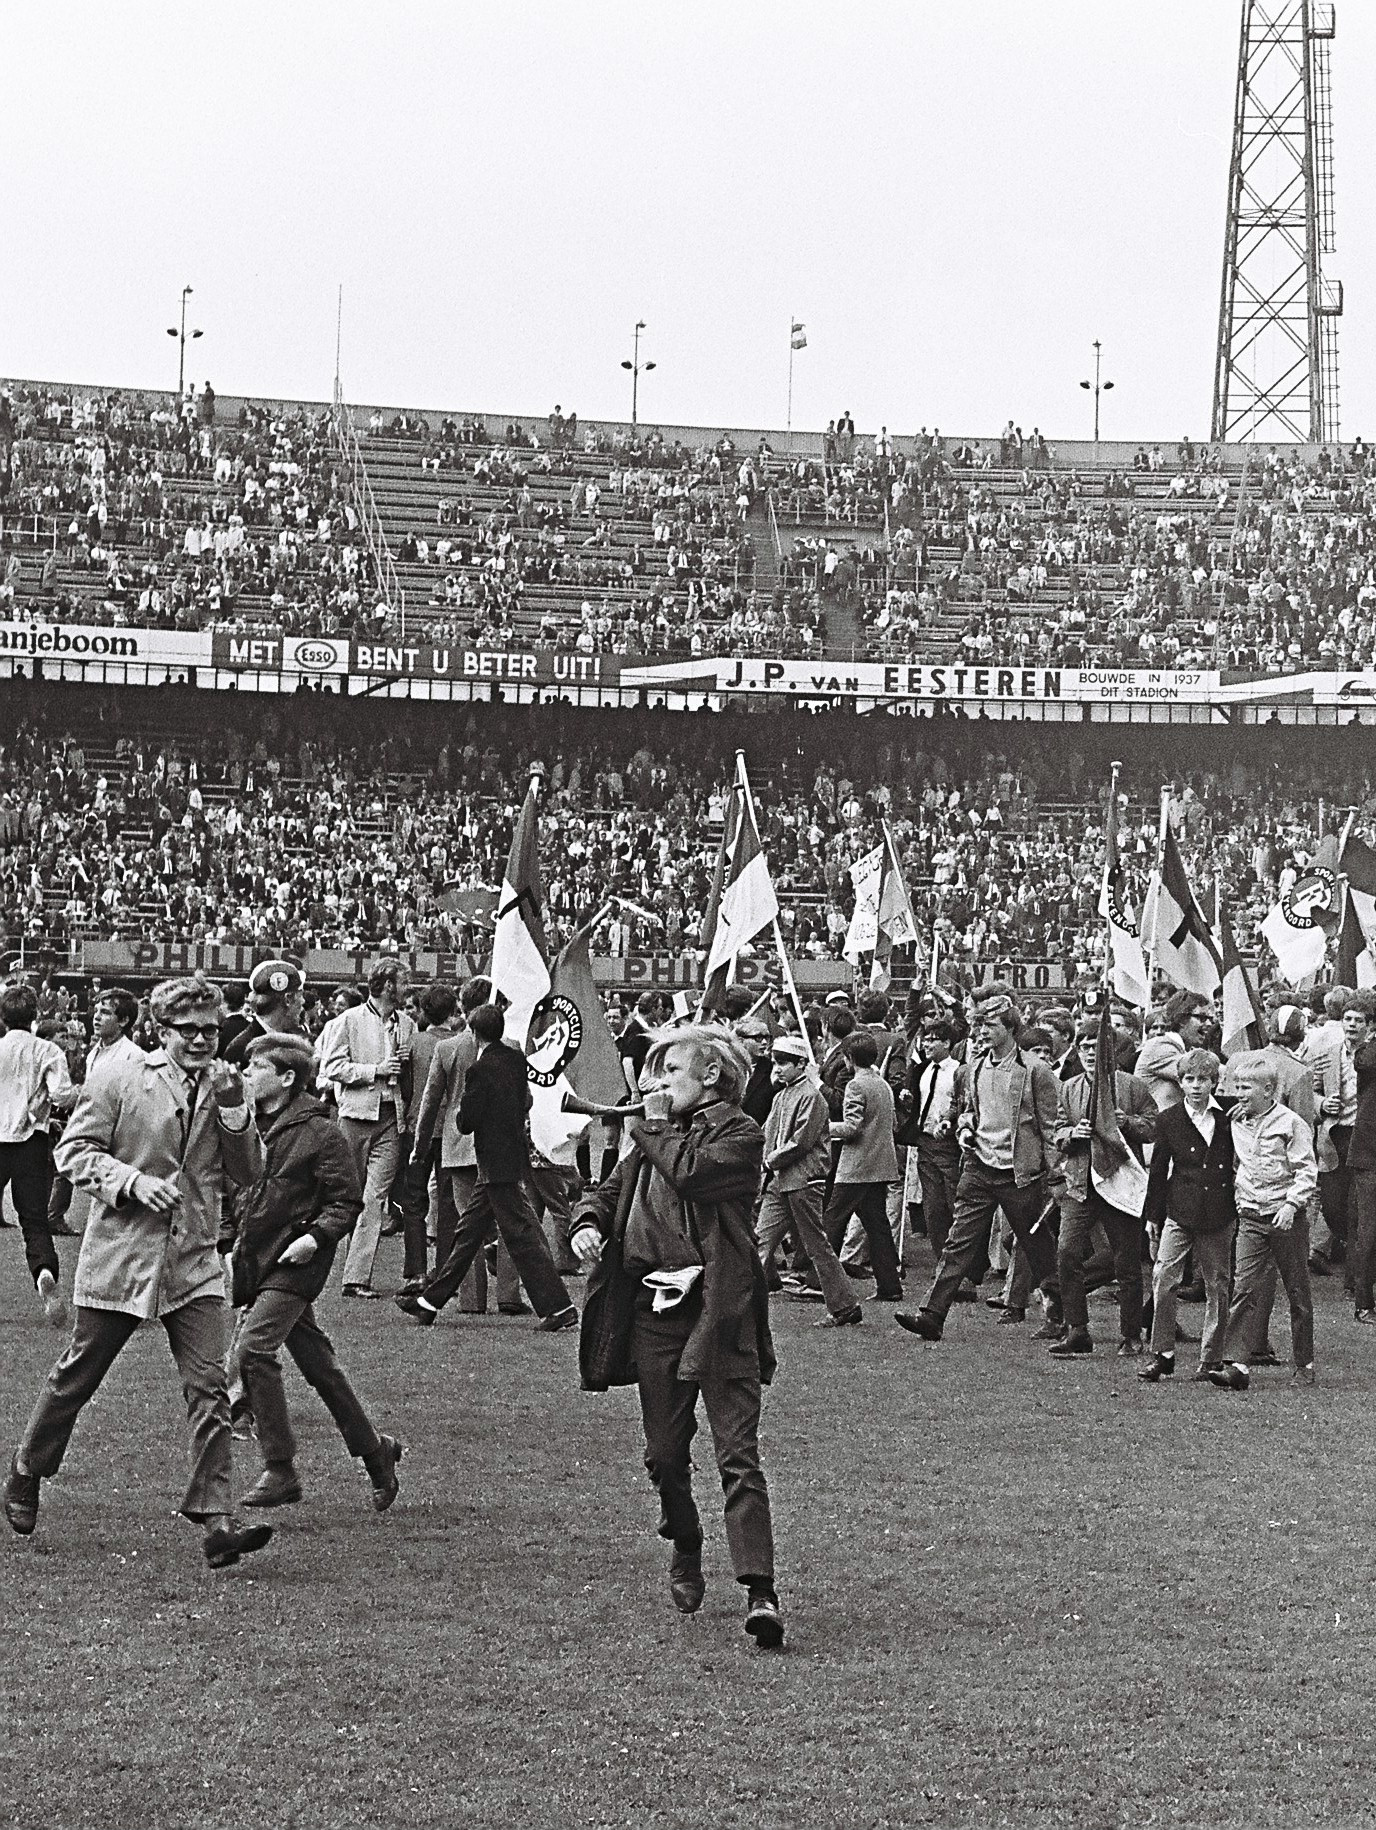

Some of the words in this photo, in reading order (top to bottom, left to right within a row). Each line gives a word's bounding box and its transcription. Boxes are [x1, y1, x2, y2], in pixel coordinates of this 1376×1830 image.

[357, 646, 419, 672] BENT
[433, 650, 448, 673] U
[464, 652, 537, 677] BETER
[553, 656, 600, 681] UIT!
[725, 661, 797, 690] J.P.
[811, 676, 859, 691] VAN
[884, 667, 1061, 698] EESTEREN
[1079, 673, 1136, 685] BOUWDE
[1148, 674, 1161, 684] IN
[1173, 674, 1200, 685] 1937
[1101, 687, 1119, 698] DIT
[1125, 687, 1179, 699] STADION
